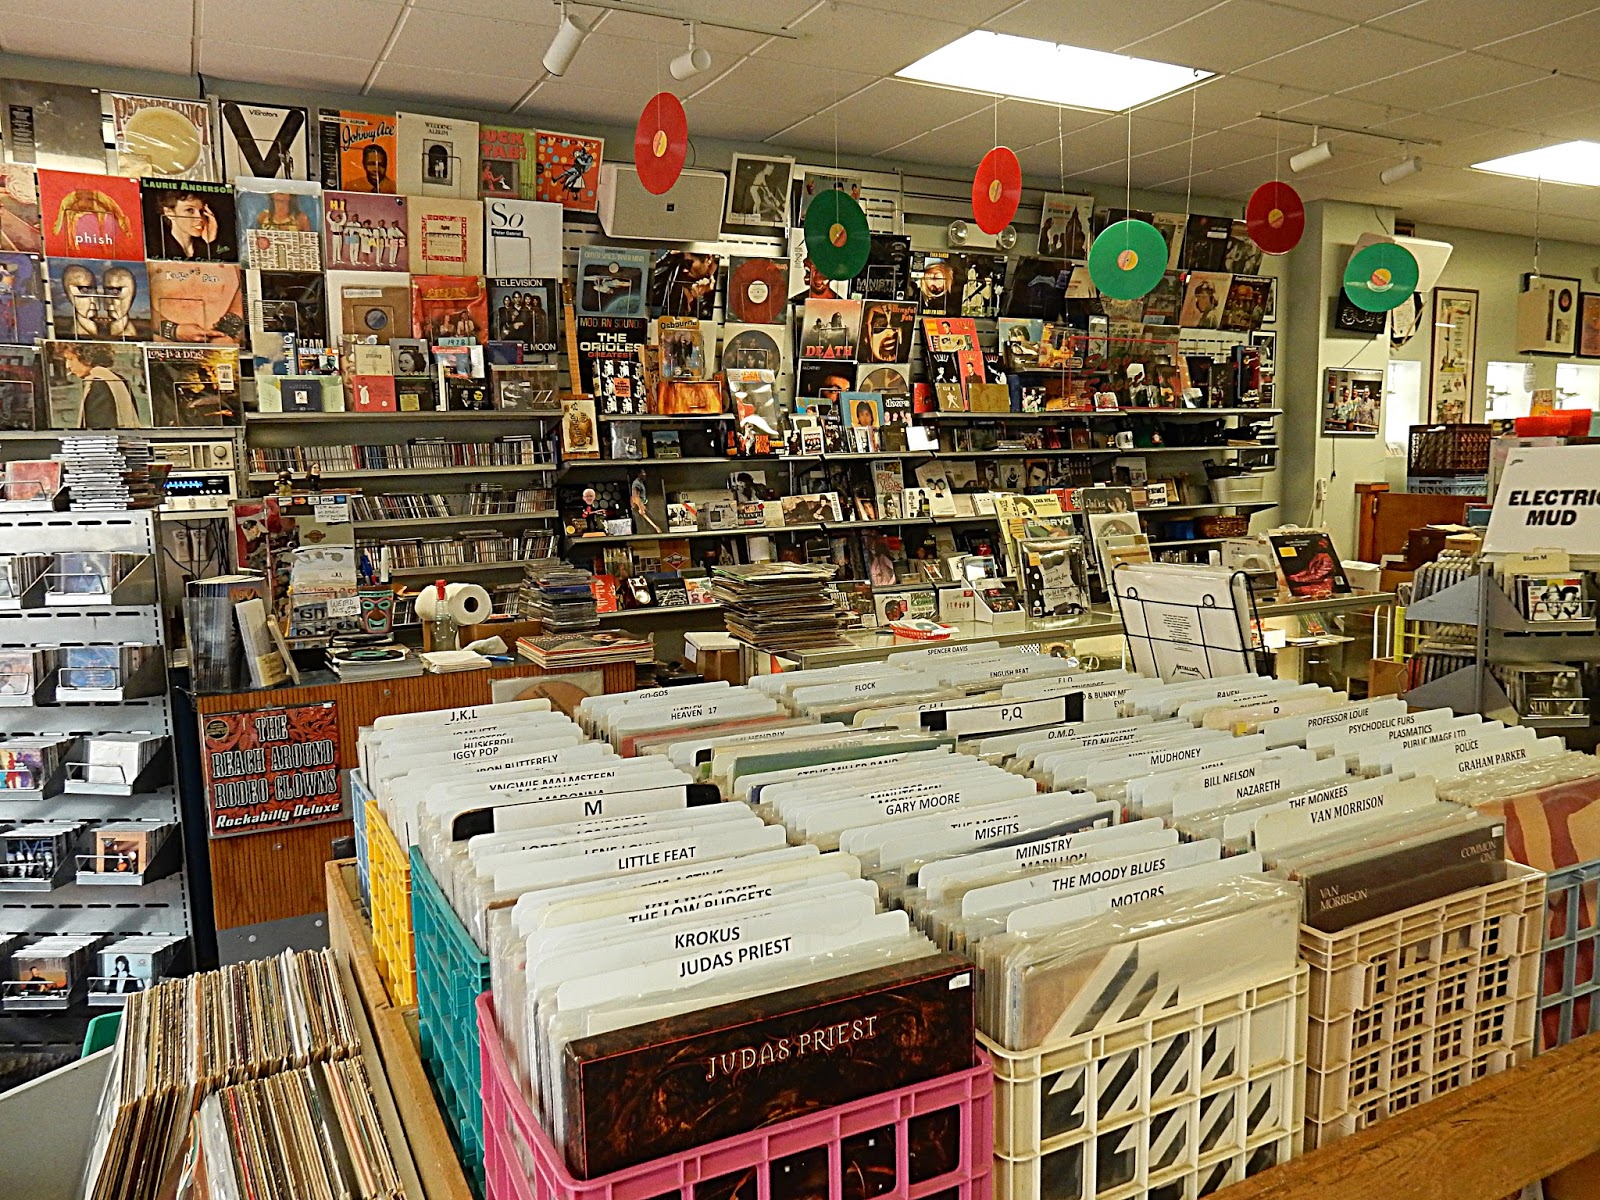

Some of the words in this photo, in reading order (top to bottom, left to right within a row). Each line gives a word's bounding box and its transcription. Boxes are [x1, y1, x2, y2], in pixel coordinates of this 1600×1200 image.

[342, 124, 377, 151] Johnny
[377, 122, 395, 137] Ace
[142, 179, 178, 190] LAURIE
[180, 182, 233, 194] ANDERSON
[491, 202, 524, 229] So
[75, 231, 113, 247] phish
[495, 278, 543, 287] TELEVISION
[856, 277, 904, 288] MINISTRY
[660, 320, 697, 330] Osbourne
[296, 338, 324, 348] REAM
[597, 332, 628, 342] THE
[530, 343, 556, 351] MOON
[805, 344, 853, 358] DEATH
[1028, 516, 1072, 527] EMBRYO
[1525, 509, 1577, 526] MUD
[927, 647, 951, 656] SPENCER
[952, 645, 968, 653] DAVIS
[989, 669, 1013, 679] ENGLISH
[1014, 667, 1029, 676] BEAT
[854, 682, 876, 692] FLOCK
[1094, 690, 1117, 699] BUNNY
[1216, 689, 1240, 699] RAVEN
[450, 709, 478, 723] J,K,L
[670, 709, 703, 721] HEAVEN
[708, 706, 718, 715] 17
[1001, 706, 1023, 721] P,Q
[1530, 701, 1550, 714] SLIM
[1307, 712, 1348, 728] PROFESSOR
[1349, 707, 1369, 719] LOUIE
[1348, 717, 1396, 735] PSYCHODELIC
[1397, 715, 1415, 726] FURS
[256, 714, 289, 742] THE
[1047, 728, 1077, 740] O.M.D.
[1388, 724, 1433, 740] PLASMATICS
[1453, 729, 1467, 738] LTD
[453, 749, 477, 761] IGGY
[479, 747, 499, 757] POP
[1454, 740, 1479, 754] POLICE
[211, 747, 266, 779] REACH
[270, 739, 334, 771] AROUND
[1150, 747, 1201, 765] MUDHONEY
[1458, 753, 1494, 773] GRAHAM
[1495, 749, 1526, 765] PARKER
[1203, 774, 1220, 788] BILL
[1222, 768, 1256, 784] NELSON
[214, 778, 269, 809] RODEO
[274, 769, 337, 801] CLOWNS
[1236, 779, 1281, 799] NAZARETH
[1307, 785, 1349, 807] MONKEES
[584, 799, 603, 817] M
[886, 800, 917, 816] GARY
[919, 792, 960, 810] MOORE
[1310, 805, 1332, 824] VAN
[1333, 795, 1384, 819] MORRISON
[215, 809, 291, 829] Rockabilly
[293, 803, 340, 818] Deluxe
[974, 822, 1020, 841] MISFITS
[1016, 837, 1073, 860] MINISTRY
[1460, 840, 1497, 859] COMMON
[618, 851, 661, 870] LITTLE
[664, 846, 697, 863] FEAT
[1052, 875, 1076, 892] THE
[1079, 864, 1128, 887] MOODY
[1130, 858, 1166, 877] BLUES
[1110, 885, 1165, 908] MOTORS
[1319, 884, 1340, 899] VAN
[1319, 889, 1369, 911] MORRISON
[674, 926, 740, 949] KROKUS
[680, 951, 734, 978] JUDAS
[738, 937, 792, 963] PRIEST
[705, 1038, 791, 1082] JUDAS
[799, 1015, 880, 1062] PRIEST
